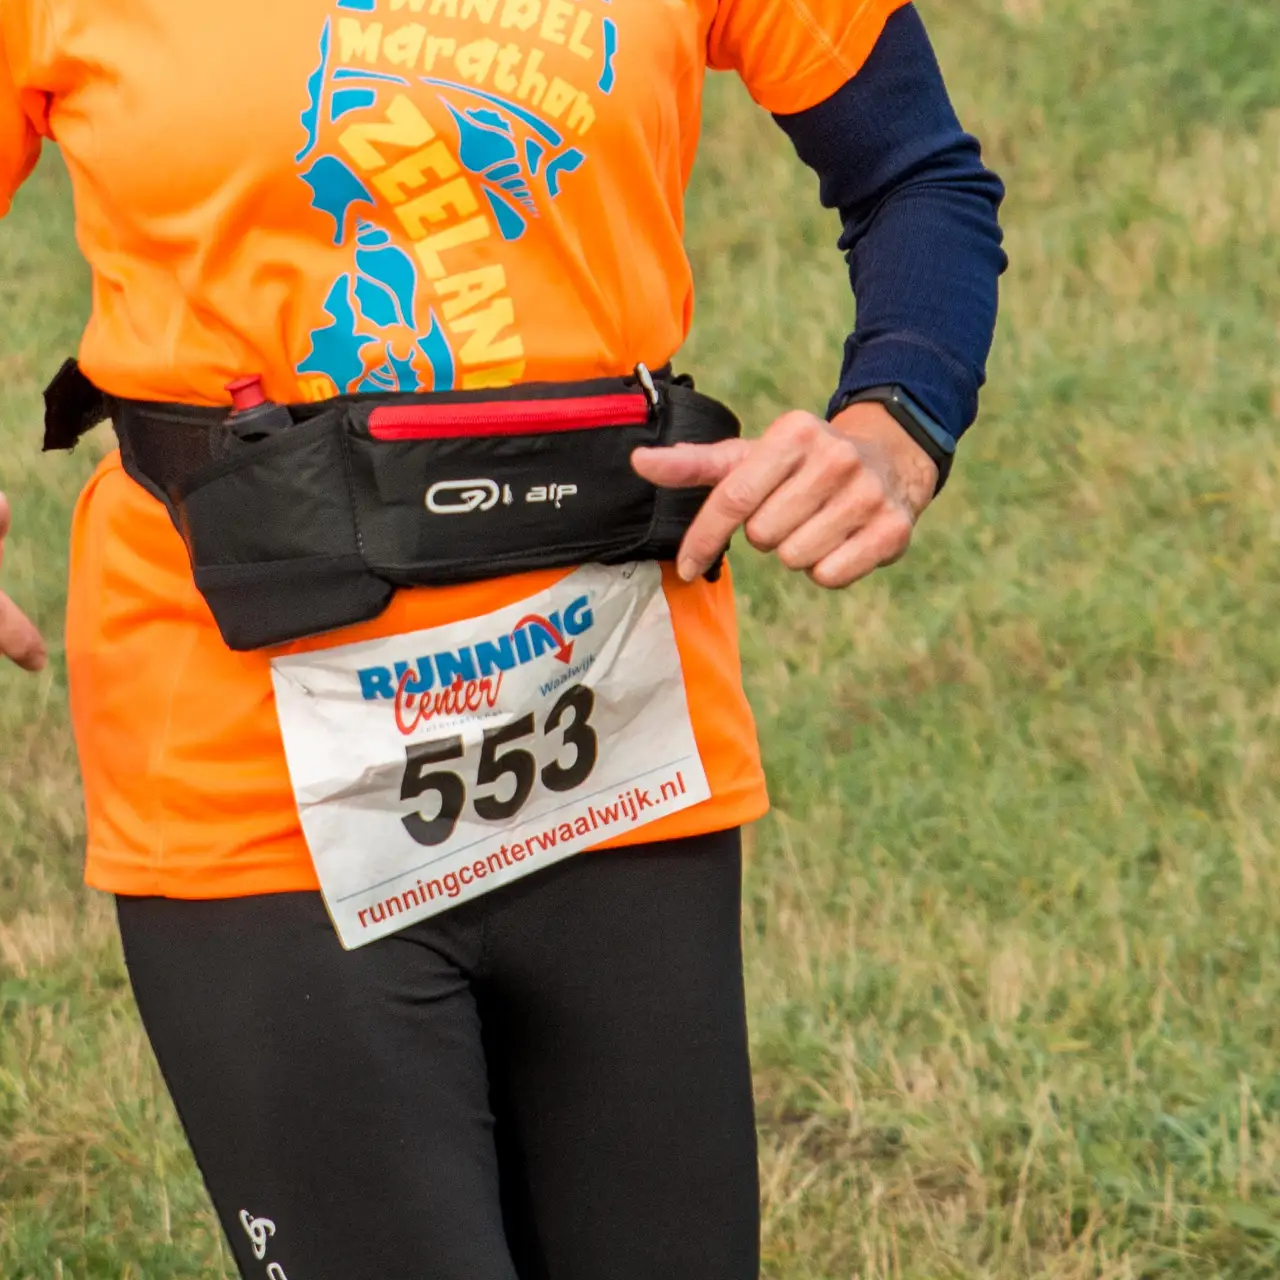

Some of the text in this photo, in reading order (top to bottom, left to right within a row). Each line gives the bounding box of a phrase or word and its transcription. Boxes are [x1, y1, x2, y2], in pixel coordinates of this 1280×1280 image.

[338, 17, 595, 136] Marathon
[357, 594, 595, 700] RUNNING
[394, 668, 503, 735] Center
[400, 683, 599, 847] 553
[357, 771, 687, 928] runningcenterwaalwijk.nl
